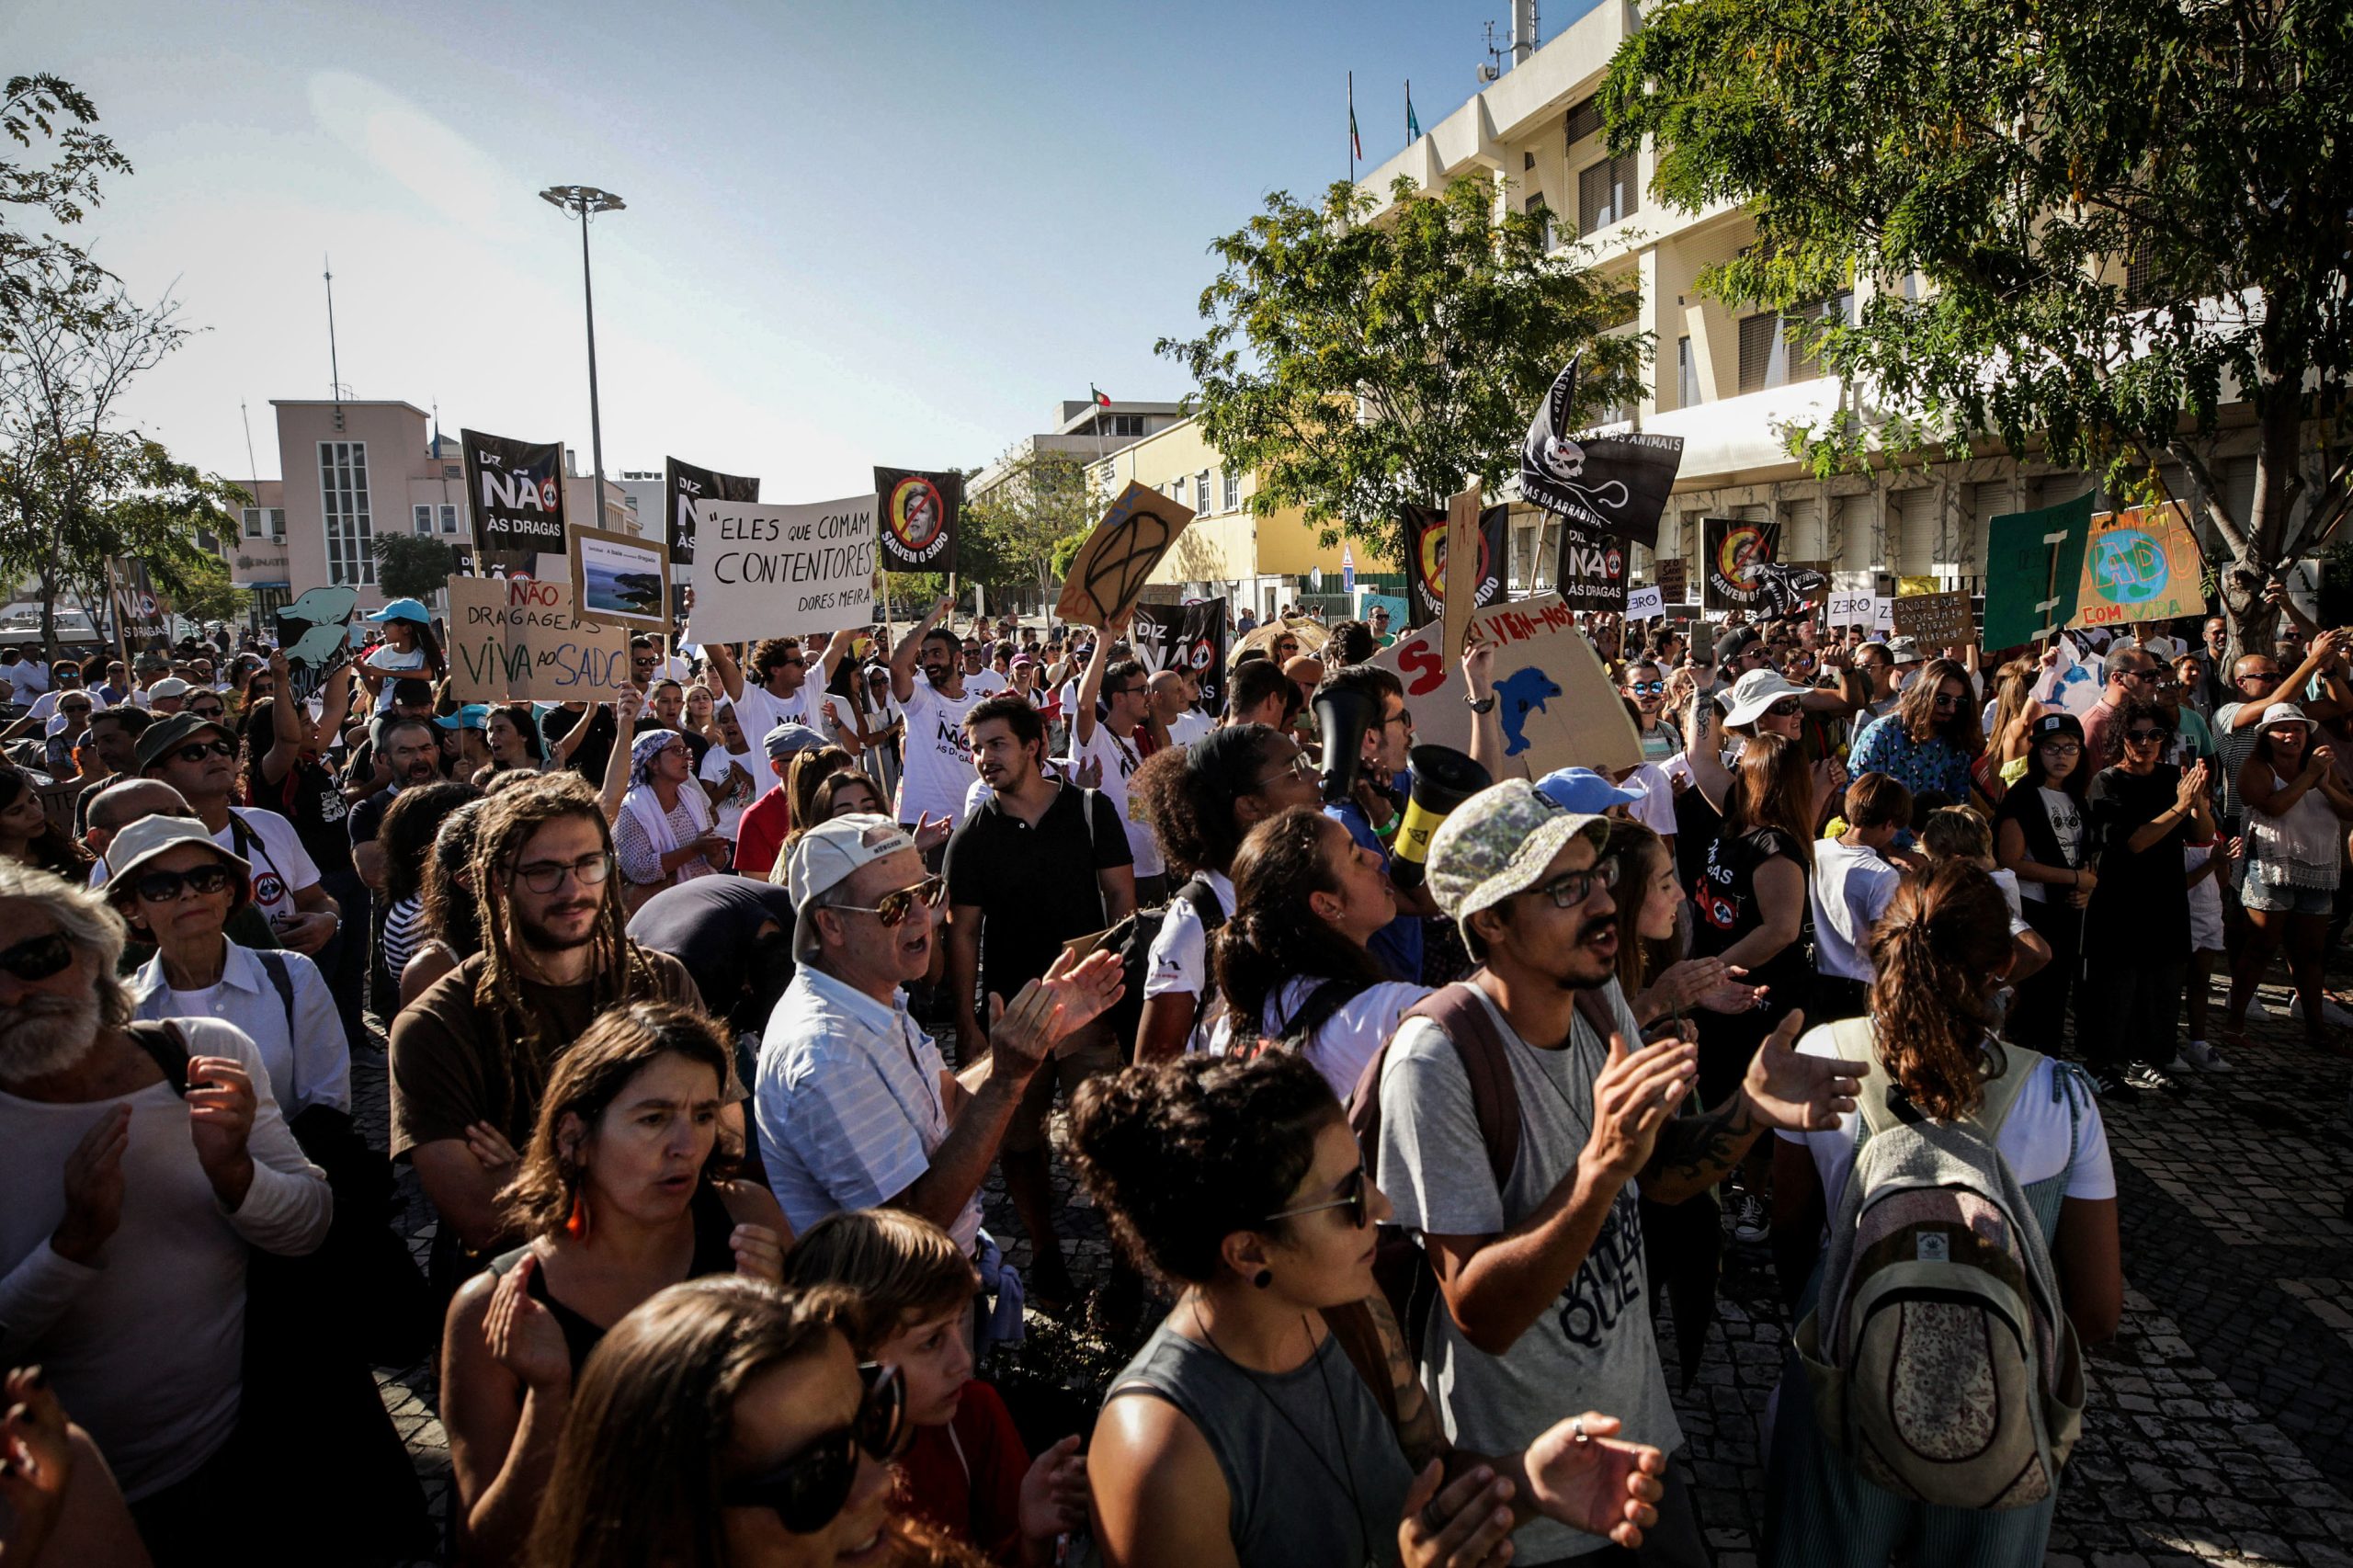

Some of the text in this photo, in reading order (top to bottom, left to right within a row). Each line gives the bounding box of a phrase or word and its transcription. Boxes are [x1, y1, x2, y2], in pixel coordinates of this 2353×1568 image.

[1629, 436, 1683, 451] ANIMAIS
[480, 449, 503, 468] DIZ
[481, 469, 559, 513] NÃO
[678, 476, 701, 494] DIZ
[1540, 493, 1553, 509] DA
[1553, 499, 1602, 528] ARRÁBIDA
[486, 514, 561, 537] ÀS DRAGAS
[787, 524, 811, 541] QUE
[817, 511, 870, 539] COMAM
[881, 530, 949, 563] SALVEM O SADO
[1568, 542, 1622, 579] NÃO
[510, 580, 559, 607] NÃO
[798, 587, 870, 612] DORES MEIRA
[1567, 581, 1621, 597] ÀS DRAGAS
[1710, 573, 1747, 603] SALVEM
[117, 583, 160, 619] NÃO
[1897, 600, 1927, 612] ONDE
[1940, 597, 1961, 608] QUE
[2083, 604, 2122, 624] COM
[123, 625, 169, 638] S DRAGAS
[1137, 622, 1168, 639] DIZ
[537, 651, 556, 666] AO
[1559, 1242, 1642, 1349] QUE
